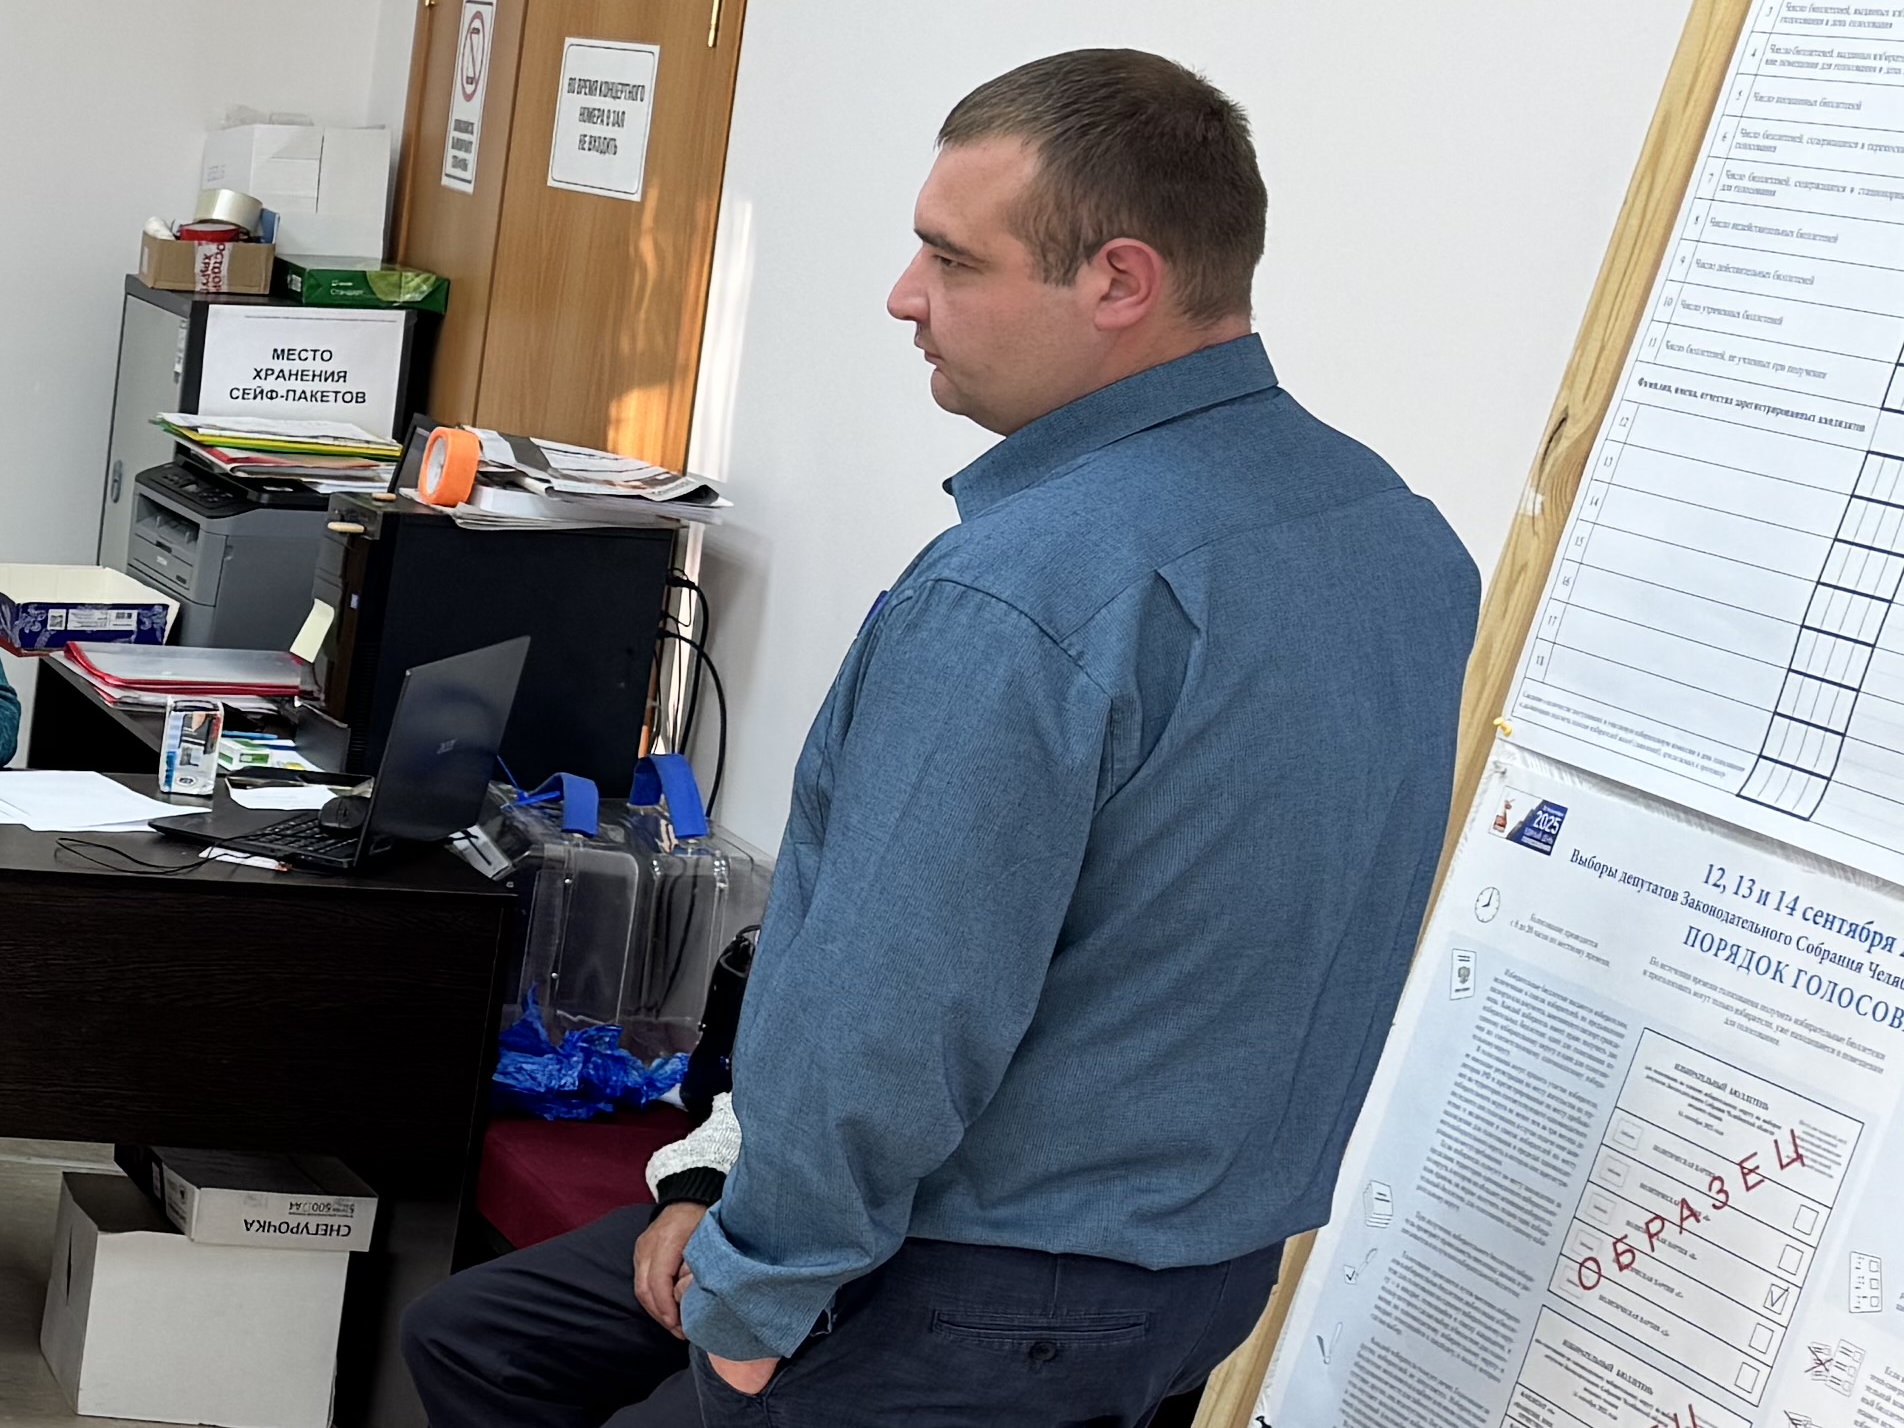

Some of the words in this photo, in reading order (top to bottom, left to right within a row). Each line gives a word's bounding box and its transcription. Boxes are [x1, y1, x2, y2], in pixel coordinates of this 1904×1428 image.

[577, 78, 598, 97] ВРЕМЯ
[600, 81, 645, 103] КОНЦЕРТНОГО
[579, 107, 605, 124] НОМЕРА
[578, 134, 587, 151] НЕ
[272, 348, 333, 362] МЕСТО
[253, 368, 347, 383] ХРАНЕНИЯ
[229, 387, 366, 404] СЕЙФ-ПАКЕТОВ
[1619, 417, 1629, 427] 12
[1590, 495, 1599, 508] 14
[1575, 536, 1584, 547] 15
[1547, 615, 1557, 626] 17
[1533, 811, 1562, 834] 2025
[1570, 848, 1618, 879] Выборы
[1618, 869, 1680, 904] депутатов
[1680, 891, 1793, 947] Законодательного
[1795, 936, 1865, 976] Собрания
[1702, 862, 1727, 894] 12,
[1733, 874, 1755, 900] 13
[1756, 886, 1771, 906] и
[1773, 890, 1799, 918] 14
[1802, 904, 1897, 955] сентября
[1683, 926, 1790, 985] ПОРЯДОК
[1578, 1128, 1805, 1291] ОБРАЗЕЦ
[244, 1219, 351, 1237] СНЕГУРОЧКА
